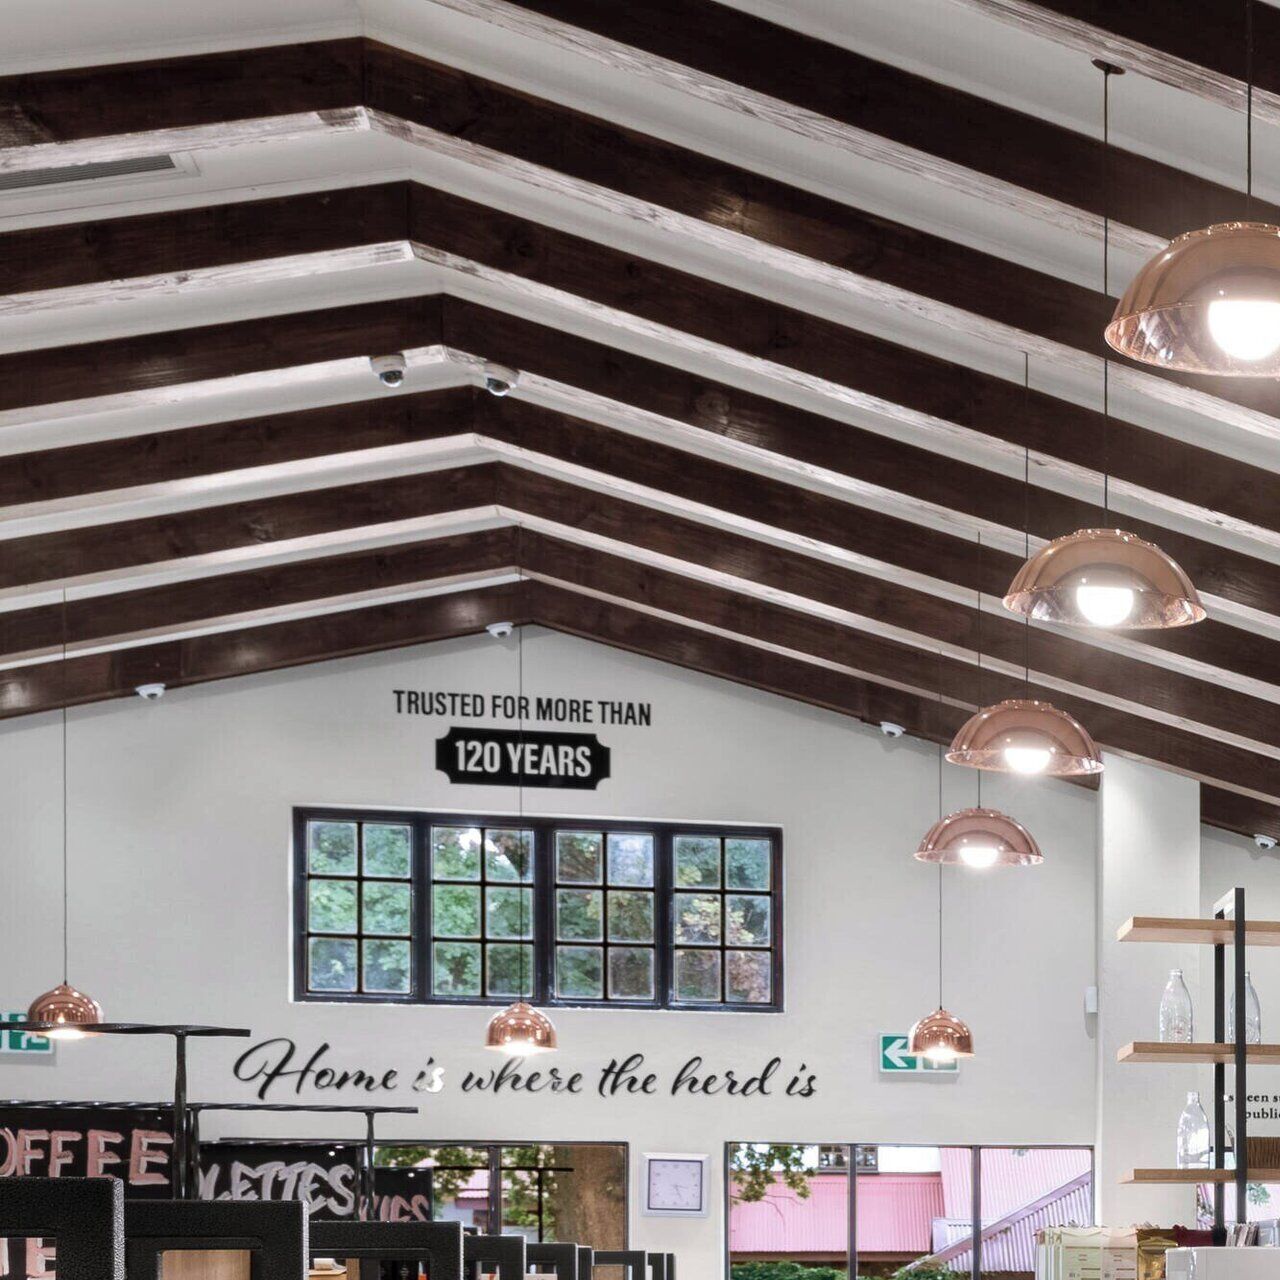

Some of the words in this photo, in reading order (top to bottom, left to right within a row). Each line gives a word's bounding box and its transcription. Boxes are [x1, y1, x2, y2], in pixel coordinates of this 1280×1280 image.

[392, 689, 485, 718] TRUSTED
[491, 695, 530, 720] FOR
[536, 697, 594, 723] MORE
[597, 700, 652, 727] THAN
[455, 739, 501, 773] 120
[506, 742, 592, 778] YEARS
[233, 1038, 399, 1100] Home
[412, 1056, 446, 1094] is
[461, 1056, 583, 1093] where
[598, 1053, 658, 1098] the
[671, 1056, 782, 1098] herd
[785, 1063, 818, 1098] is
